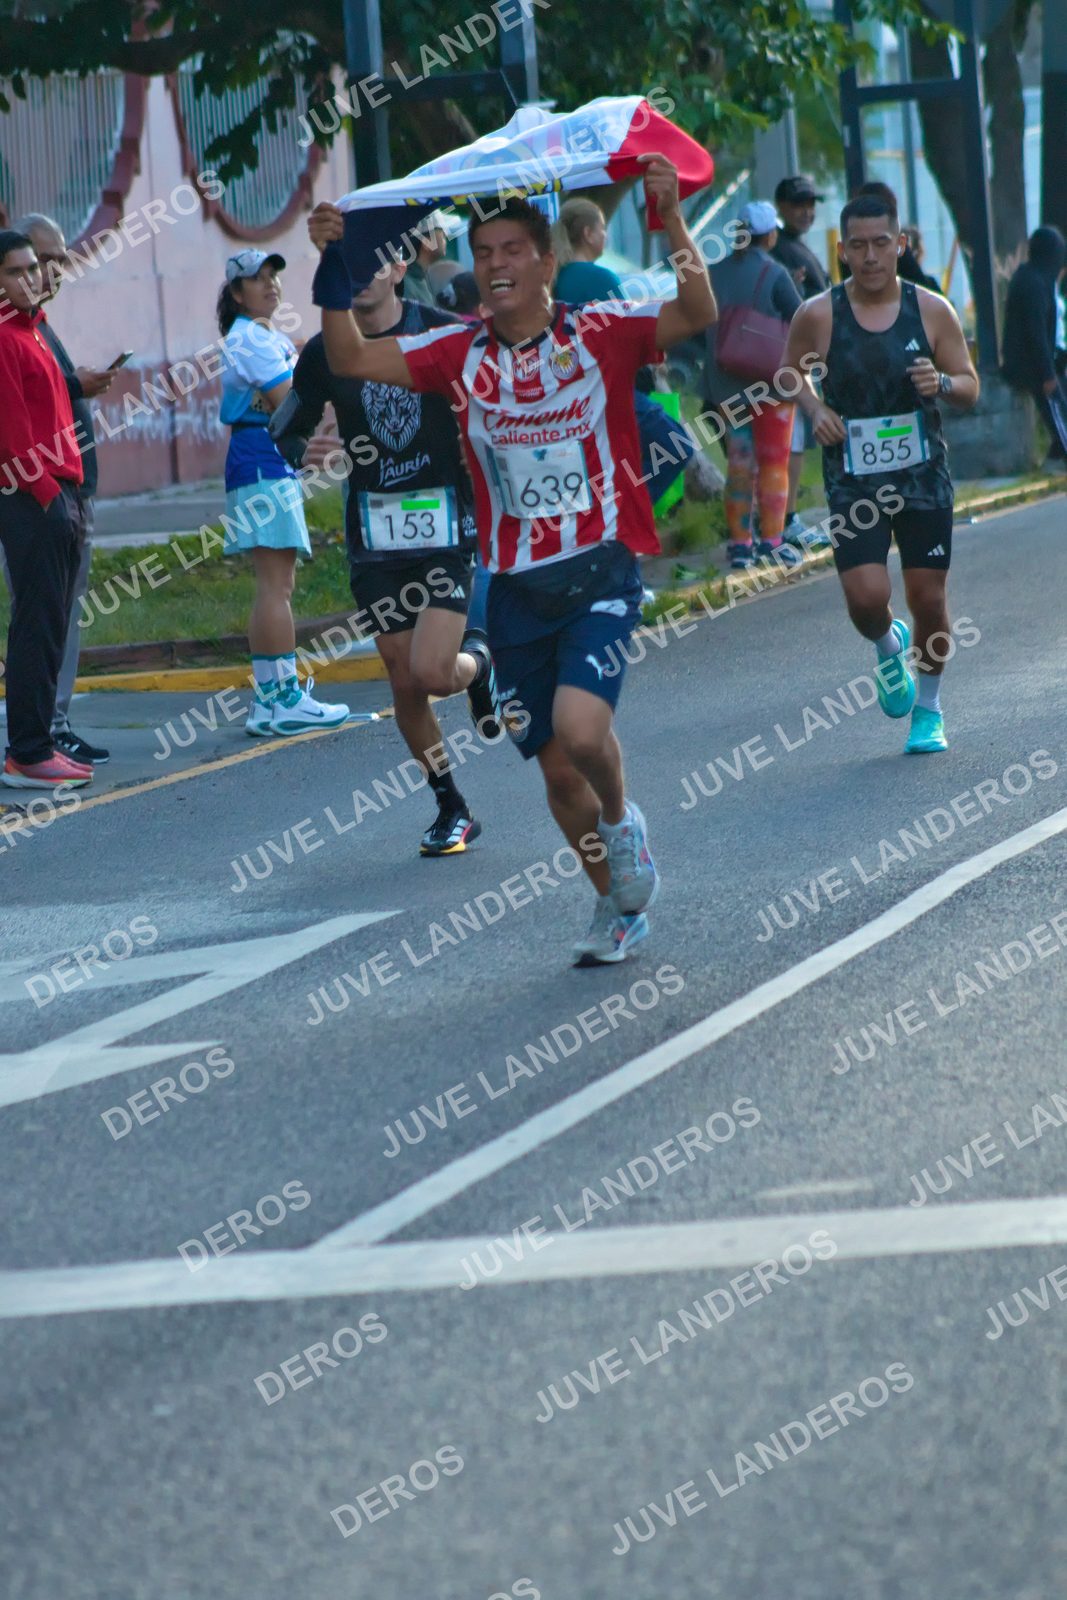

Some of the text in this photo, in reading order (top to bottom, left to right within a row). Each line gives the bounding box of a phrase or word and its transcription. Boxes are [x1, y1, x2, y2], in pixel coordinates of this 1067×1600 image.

[491, 420, 591, 445] caliente.mx
[862, 437, 911, 465] 855
[502, 471, 583, 508] 1639
[385, 512, 436, 541] 153
